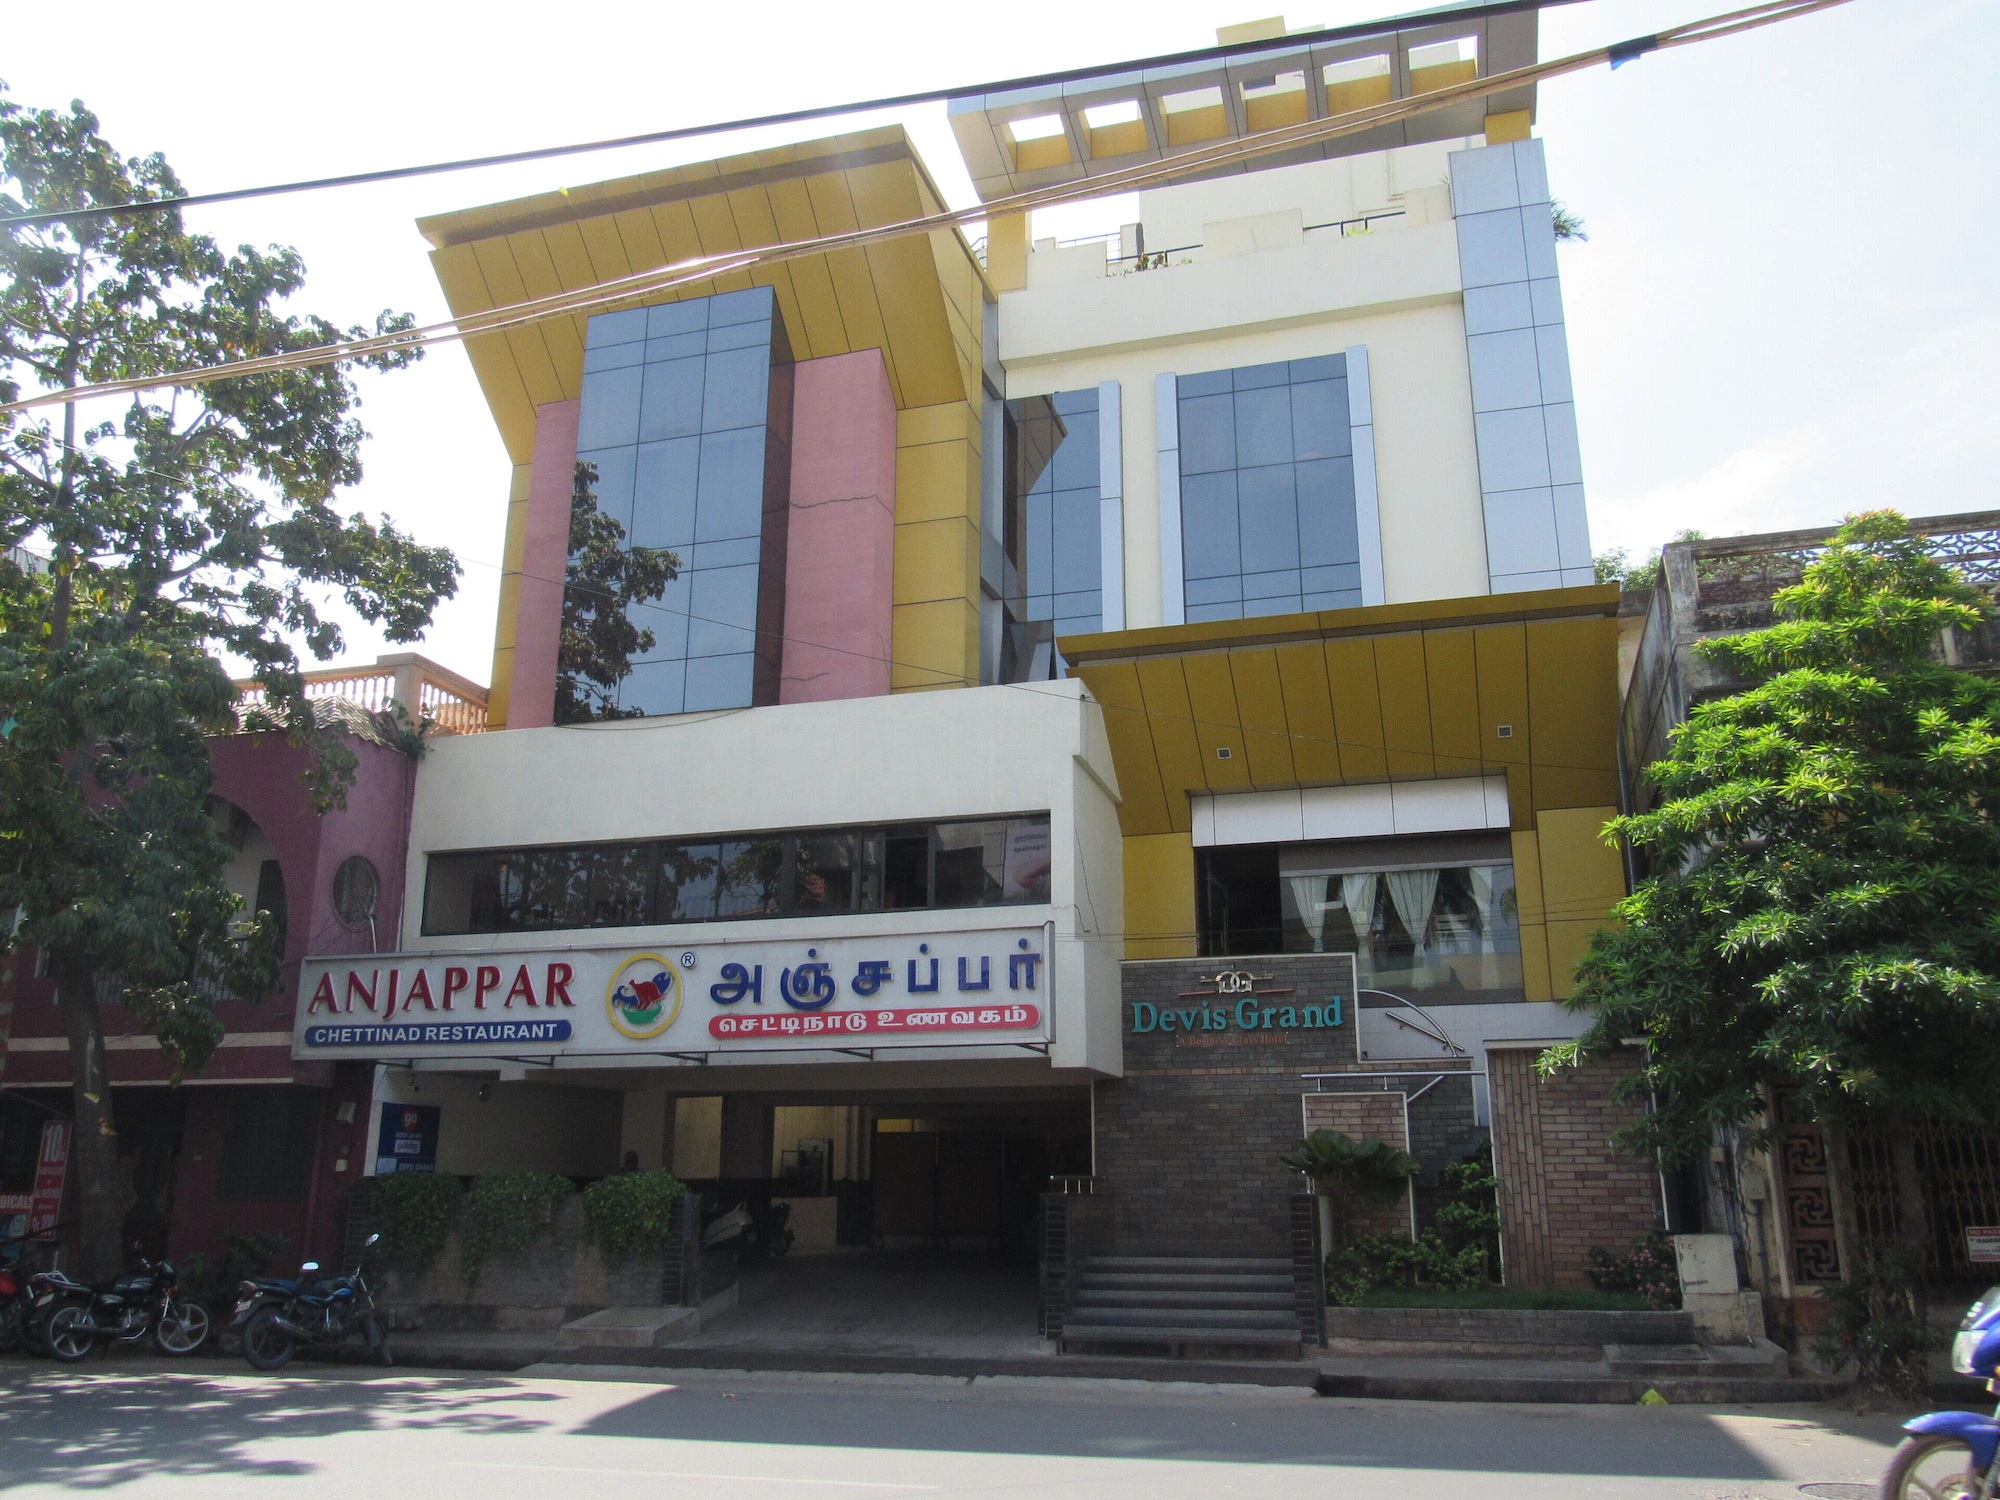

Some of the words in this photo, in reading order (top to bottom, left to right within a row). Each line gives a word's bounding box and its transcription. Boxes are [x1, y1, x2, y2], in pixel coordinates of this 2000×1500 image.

[710, 938, 1042, 1010] அஞ்சப்பர்
[308, 962, 577, 1020] ANJAPPAR
[719, 1010, 868, 1034] செட்டிநாடு
[877, 1004, 1028, 1028] உணவகம்
[1132, 1000, 1228, 1032] Devis
[1236, 995, 1343, 1029] Grand
[315, 1026, 424, 1043] CHETTINAD
[425, 1023, 558, 1041] RESTAURANT
[405, 1113, 418, 1126] go
